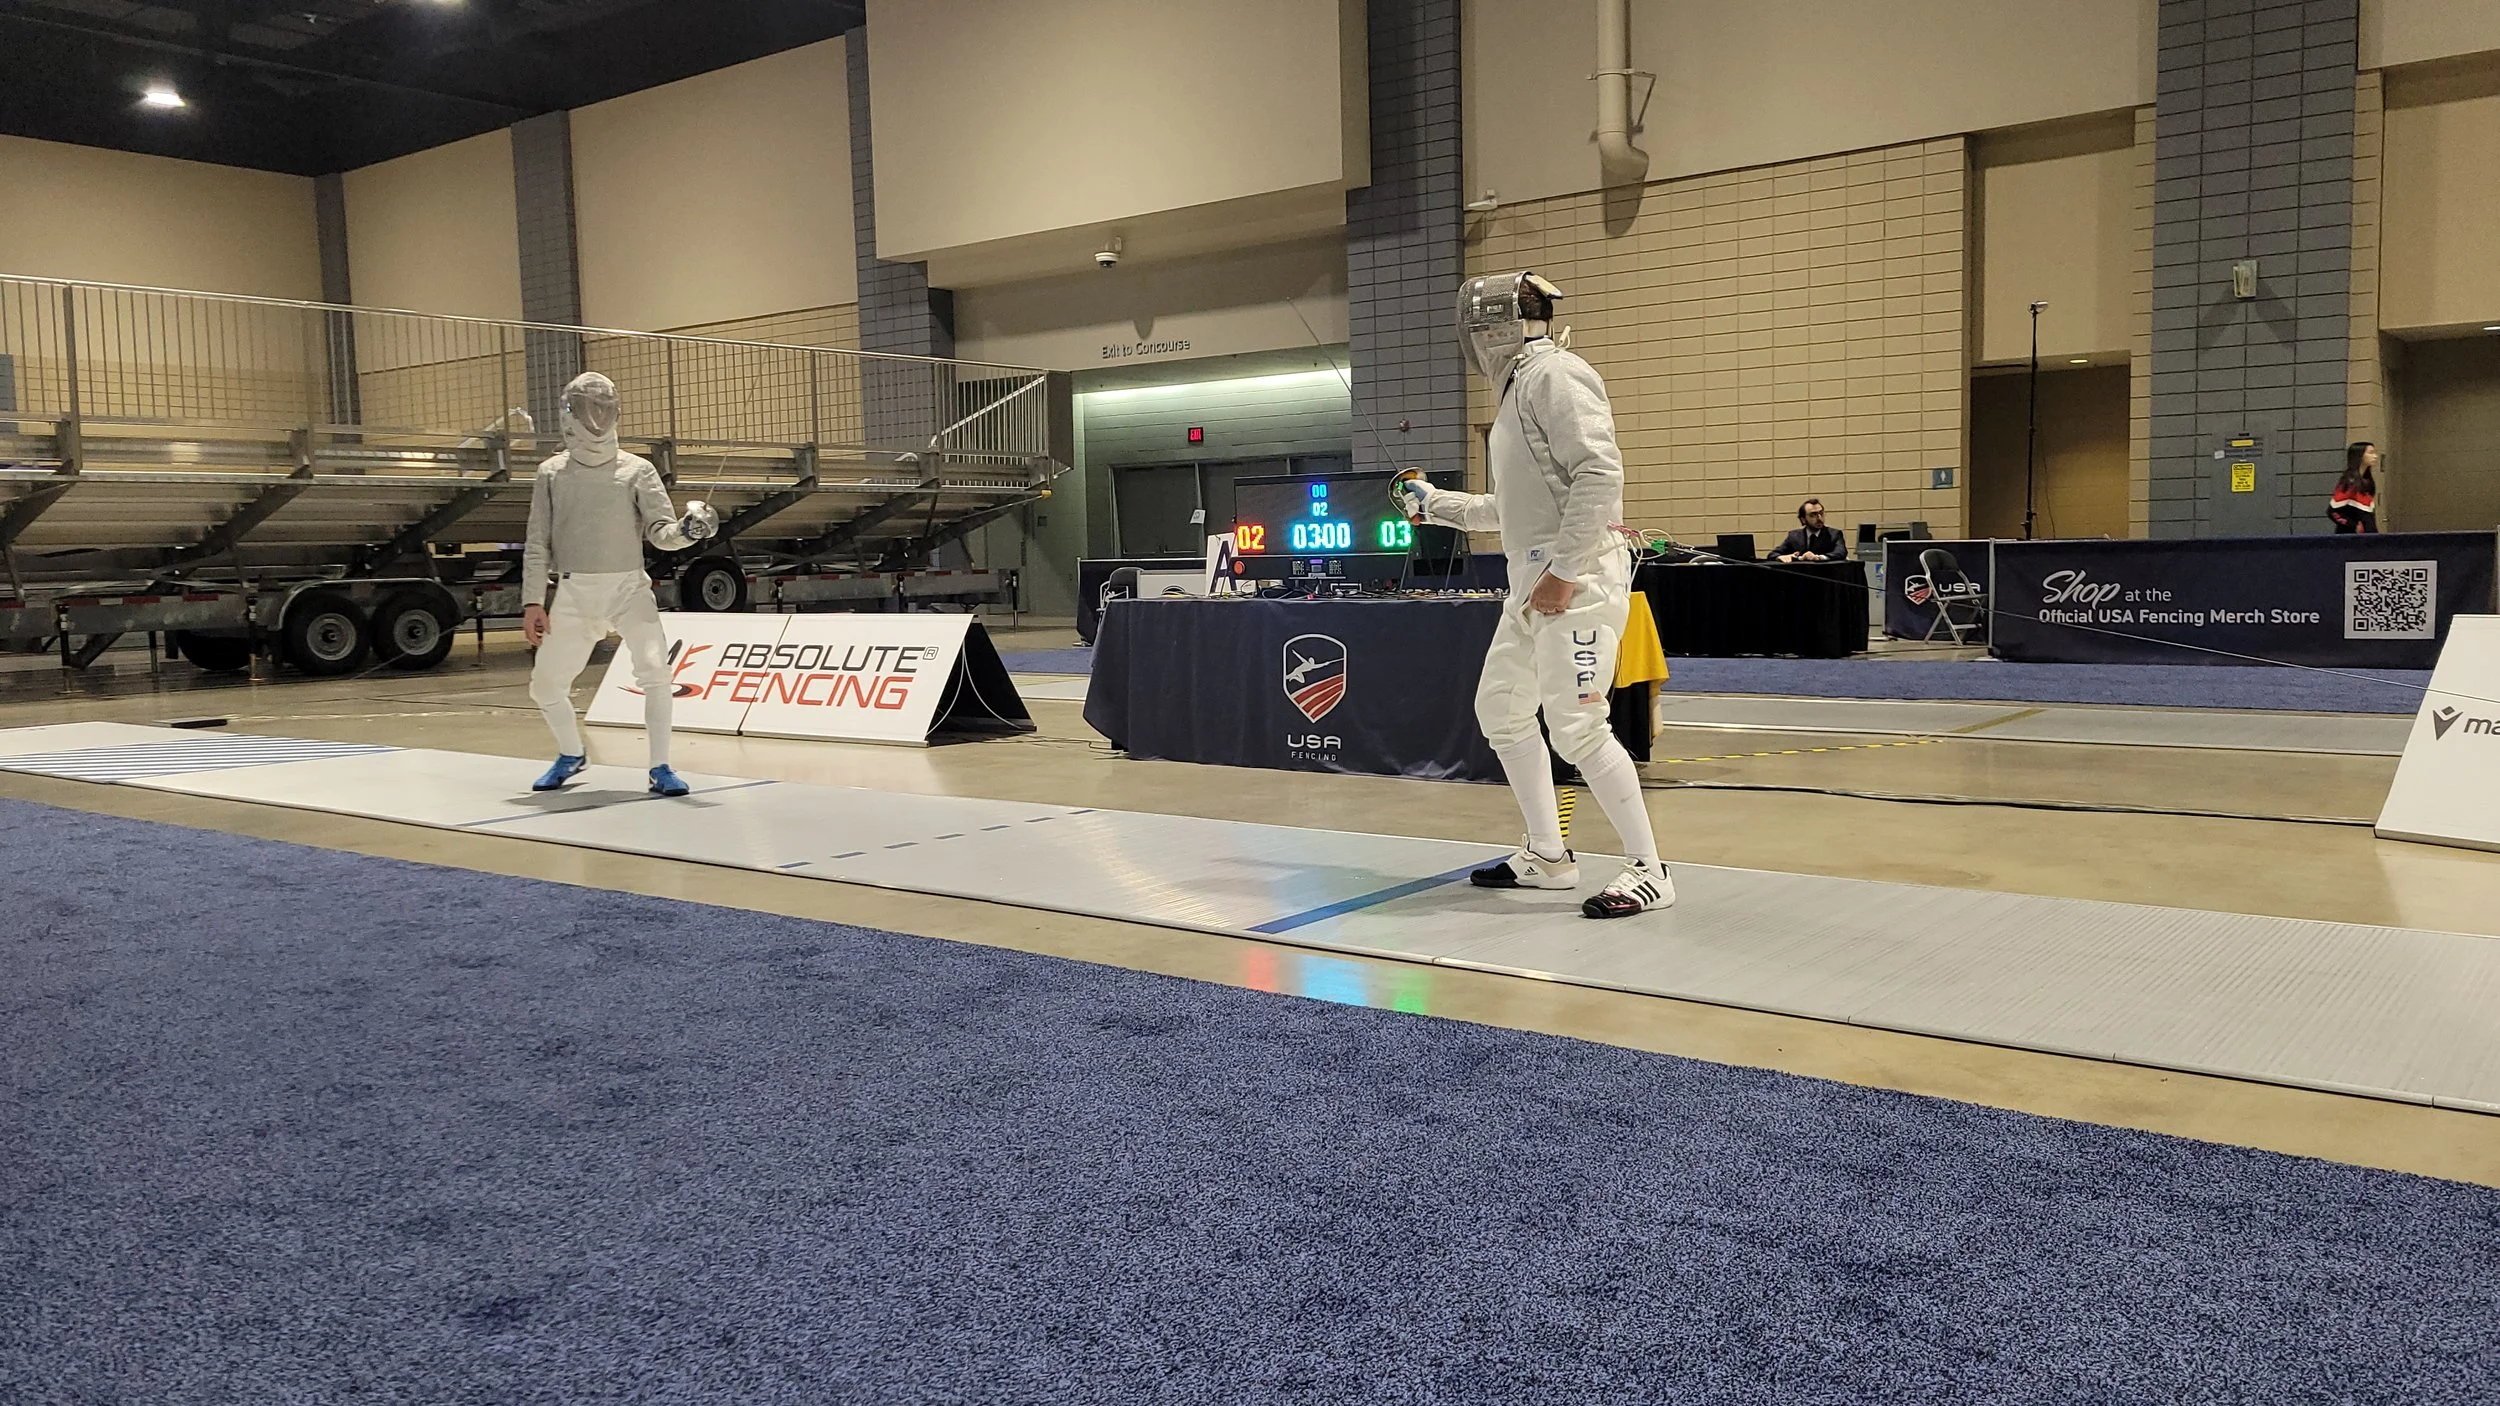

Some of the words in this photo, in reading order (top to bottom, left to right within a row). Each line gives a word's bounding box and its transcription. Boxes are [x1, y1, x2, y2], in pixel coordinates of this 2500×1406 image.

[1102, 344, 1120, 359] Exit
[1123, 344, 1133, 357] to
[1136, 340, 1191, 356] Concourse
[1311, 484, 1328, 498] 00
[1312, 502, 1328, 517] 02
[1237, 524, 1265, 551] 02
[1380, 520, 1412, 547] 03
[1209, 540, 1238, 592] A
[1939, 582, 1981, 593] USA
[2042, 569, 2121, 611] Shop
[2124, 589, 2141, 602] at
[2145, 587, 2172, 602] the
[2039, 608, 2093, 623] Official
[2098, 608, 2135, 624] USA
[2139, 608, 2204, 627] Fencing
[2210, 608, 2265, 624] Merch
[2270, 608, 2320, 624] Store
[1572, 630, 1597, 688] USA
[701, 670, 914, 710] FENCING
[1287, 734, 1341, 750] USA
[1291, 751, 1337, 762] FENCING
